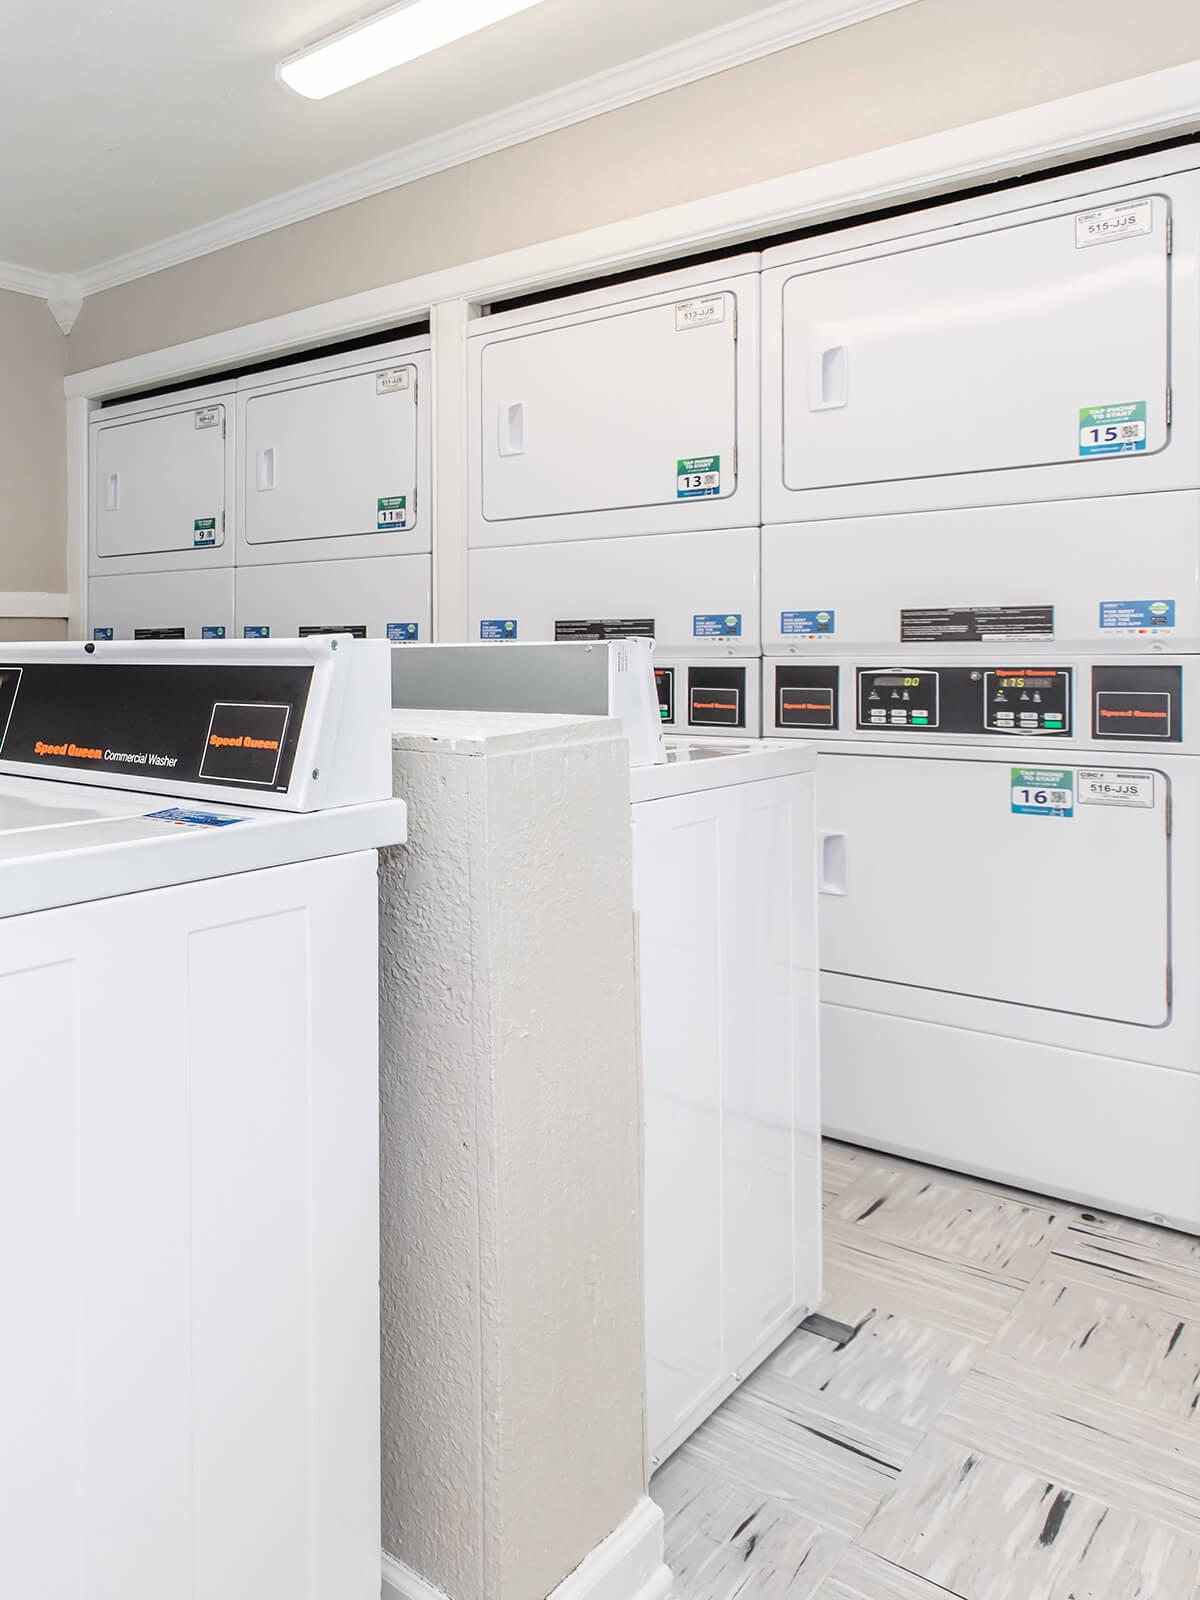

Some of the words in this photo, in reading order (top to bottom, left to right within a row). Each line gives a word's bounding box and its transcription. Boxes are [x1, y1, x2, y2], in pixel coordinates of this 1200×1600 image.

[1088, 216, 1136, 233] 515-JJS
[1090, 427, 1117, 442] 15
[684, 476, 701, 488] 13
[382, 512, 393, 521] 11
[199, 531, 204, 539] 9
[210, 734, 243, 747] Speed
[243, 735, 279, 750] Queen
[35, 741, 68, 756] Speed
[68, 744, 102, 759] Queen
[104, 749, 147, 764] Commercial
[148, 754, 178, 768] Washer
[1090, 784, 1138, 793] 516-JJS
[1021, 790, 1047, 804] 16
